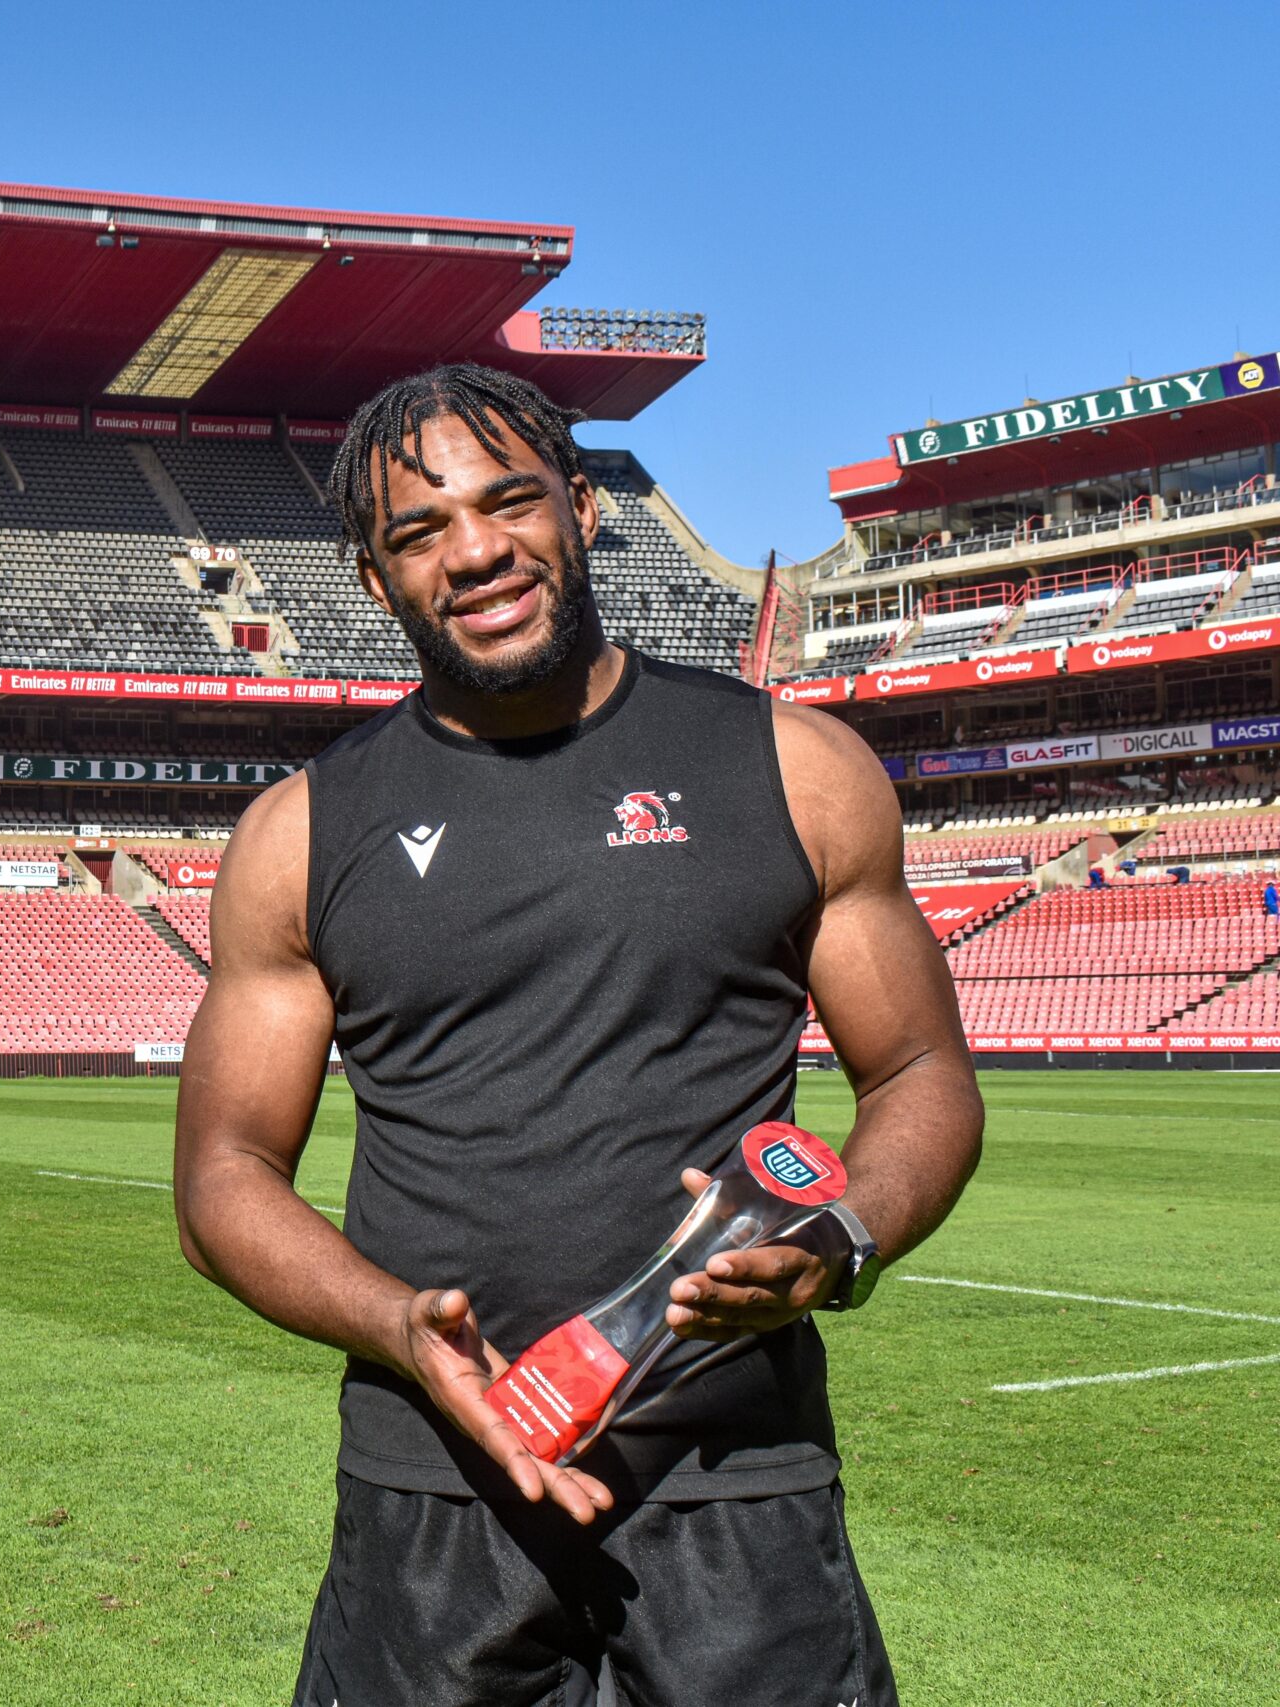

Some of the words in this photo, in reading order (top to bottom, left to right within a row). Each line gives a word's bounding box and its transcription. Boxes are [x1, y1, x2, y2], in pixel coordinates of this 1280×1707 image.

[962, 372, 1210, 448] FIDELITY
[43, 413, 55, 425] FLY
[55, 414, 79, 426] BETTER
[96, 417, 139, 429] Emirates
[142, 419, 153, 430] FLY
[153, 420, 177, 431] BETTER
[192, 422, 234, 434] Emirates
[237, 424, 248, 434] FLY
[248, 424, 272, 435] BETTER
[289, 426, 331, 438] Emirates
[190, 547, 210, 560] 69
[215, 548, 236, 561] 70
[1228, 629, 1272, 644] vodapay
[1111, 645, 1153, 658] vodapay
[994, 661, 1033, 674] vodapay
[11, 675, 67, 690] Emirates
[71, 678, 86, 691] FLY
[87, 678, 116, 692] BETTER
[125, 679, 180, 694] Emirates
[183, 682, 198, 694] FLY
[199, 682, 228, 696] BETTER
[894, 675, 931, 687] vodapay
[236, 683, 290, 698] Emirates
[294, 685, 308, 697] FLY
[308, 685, 337, 698] BETTER
[350, 686, 405, 700] Emirates
[796, 686, 832, 699] vodapay
[1123, 730, 1198, 753] DIGICALL
[1011, 743, 1093, 763] GLASFIT
[606, 827, 690, 847] LIONS
[10, 865, 57, 874] NETSTAR
[904, 862, 961, 872] DEVELOPMENT
[963, 857, 1022, 868] CORPORATION
[975, 1038, 1007, 1047] xerox
[1011, 1037, 1043, 1047] xerox
[1051, 1037, 1084, 1047] xerox
[1088, 1037, 1122, 1047] xerox
[1127, 1037, 1162, 1047] xerox
[1170, 1037, 1205, 1047] xerox
[1210, 1037, 1246, 1047] xerox
